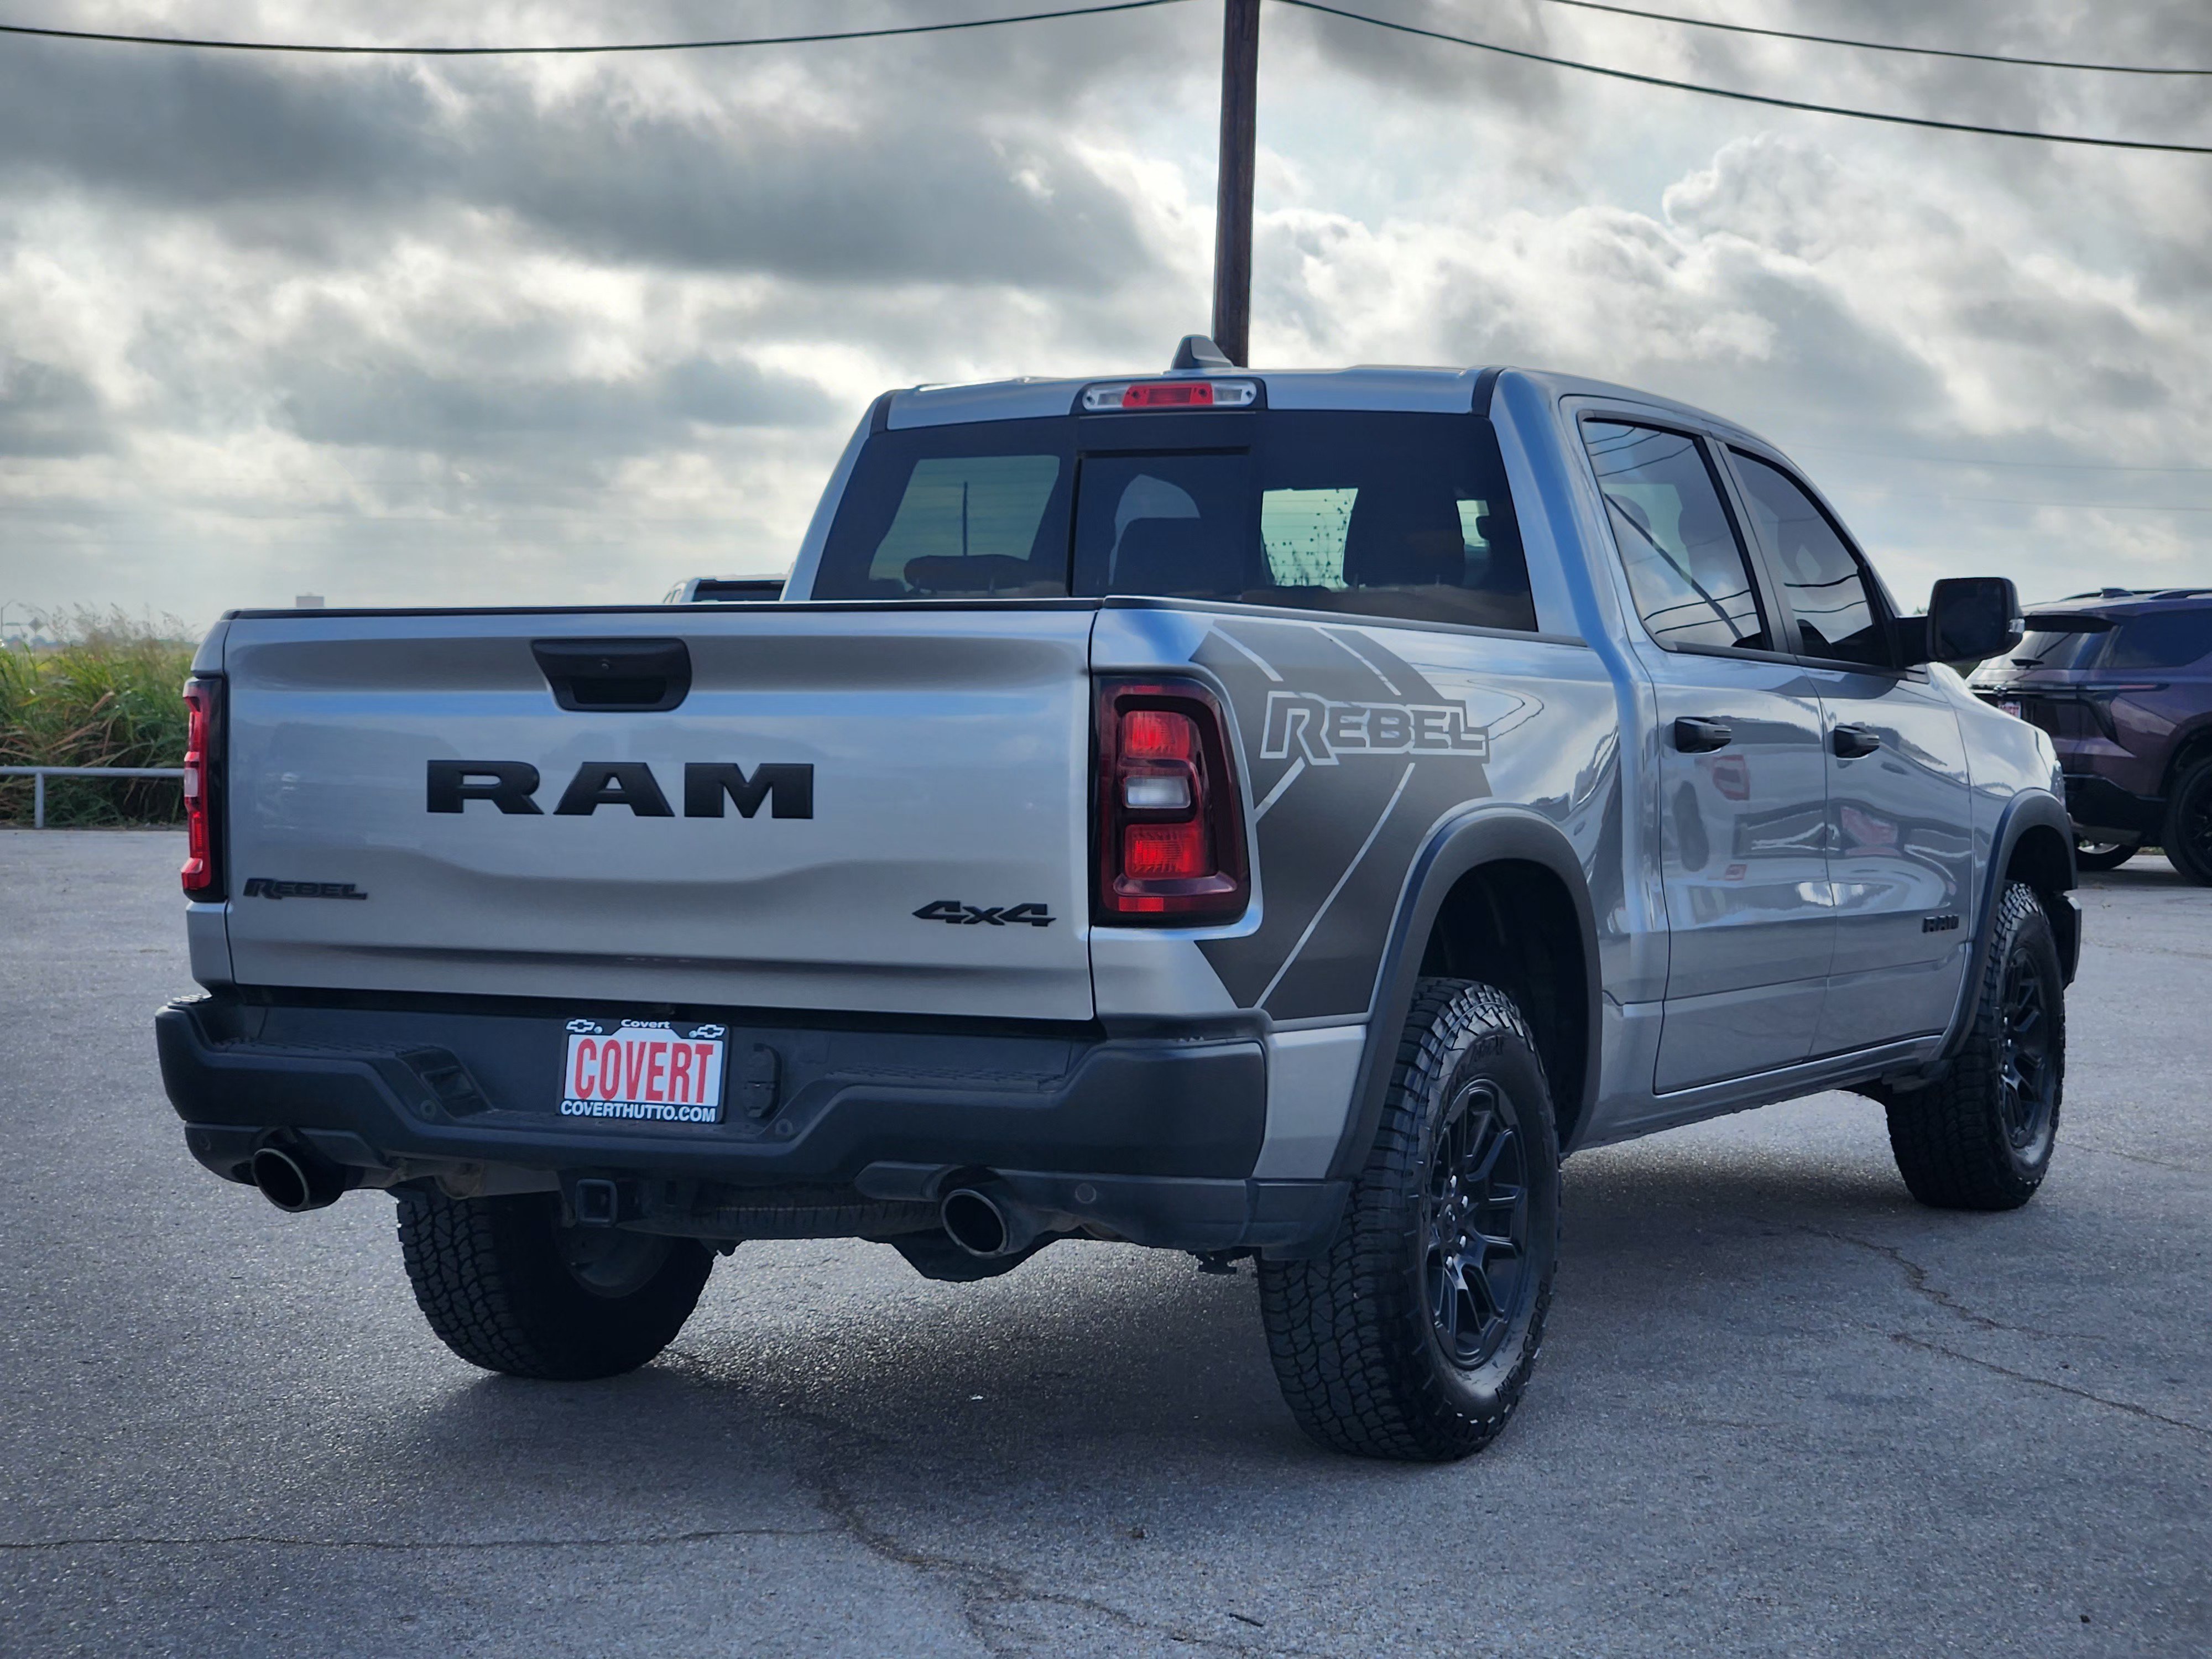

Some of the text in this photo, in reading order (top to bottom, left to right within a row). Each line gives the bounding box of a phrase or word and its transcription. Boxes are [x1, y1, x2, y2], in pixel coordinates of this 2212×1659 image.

[1260, 691, 1486, 766] REBEL
[427, 759, 813, 819] RAM
[911, 900, 1057, 927] 4x4
[620, 1019, 670, 1029] Covert
[575, 1039, 714, 1104] COVERT
[560, 1100, 716, 1123] COVERTHUTTO.COM
